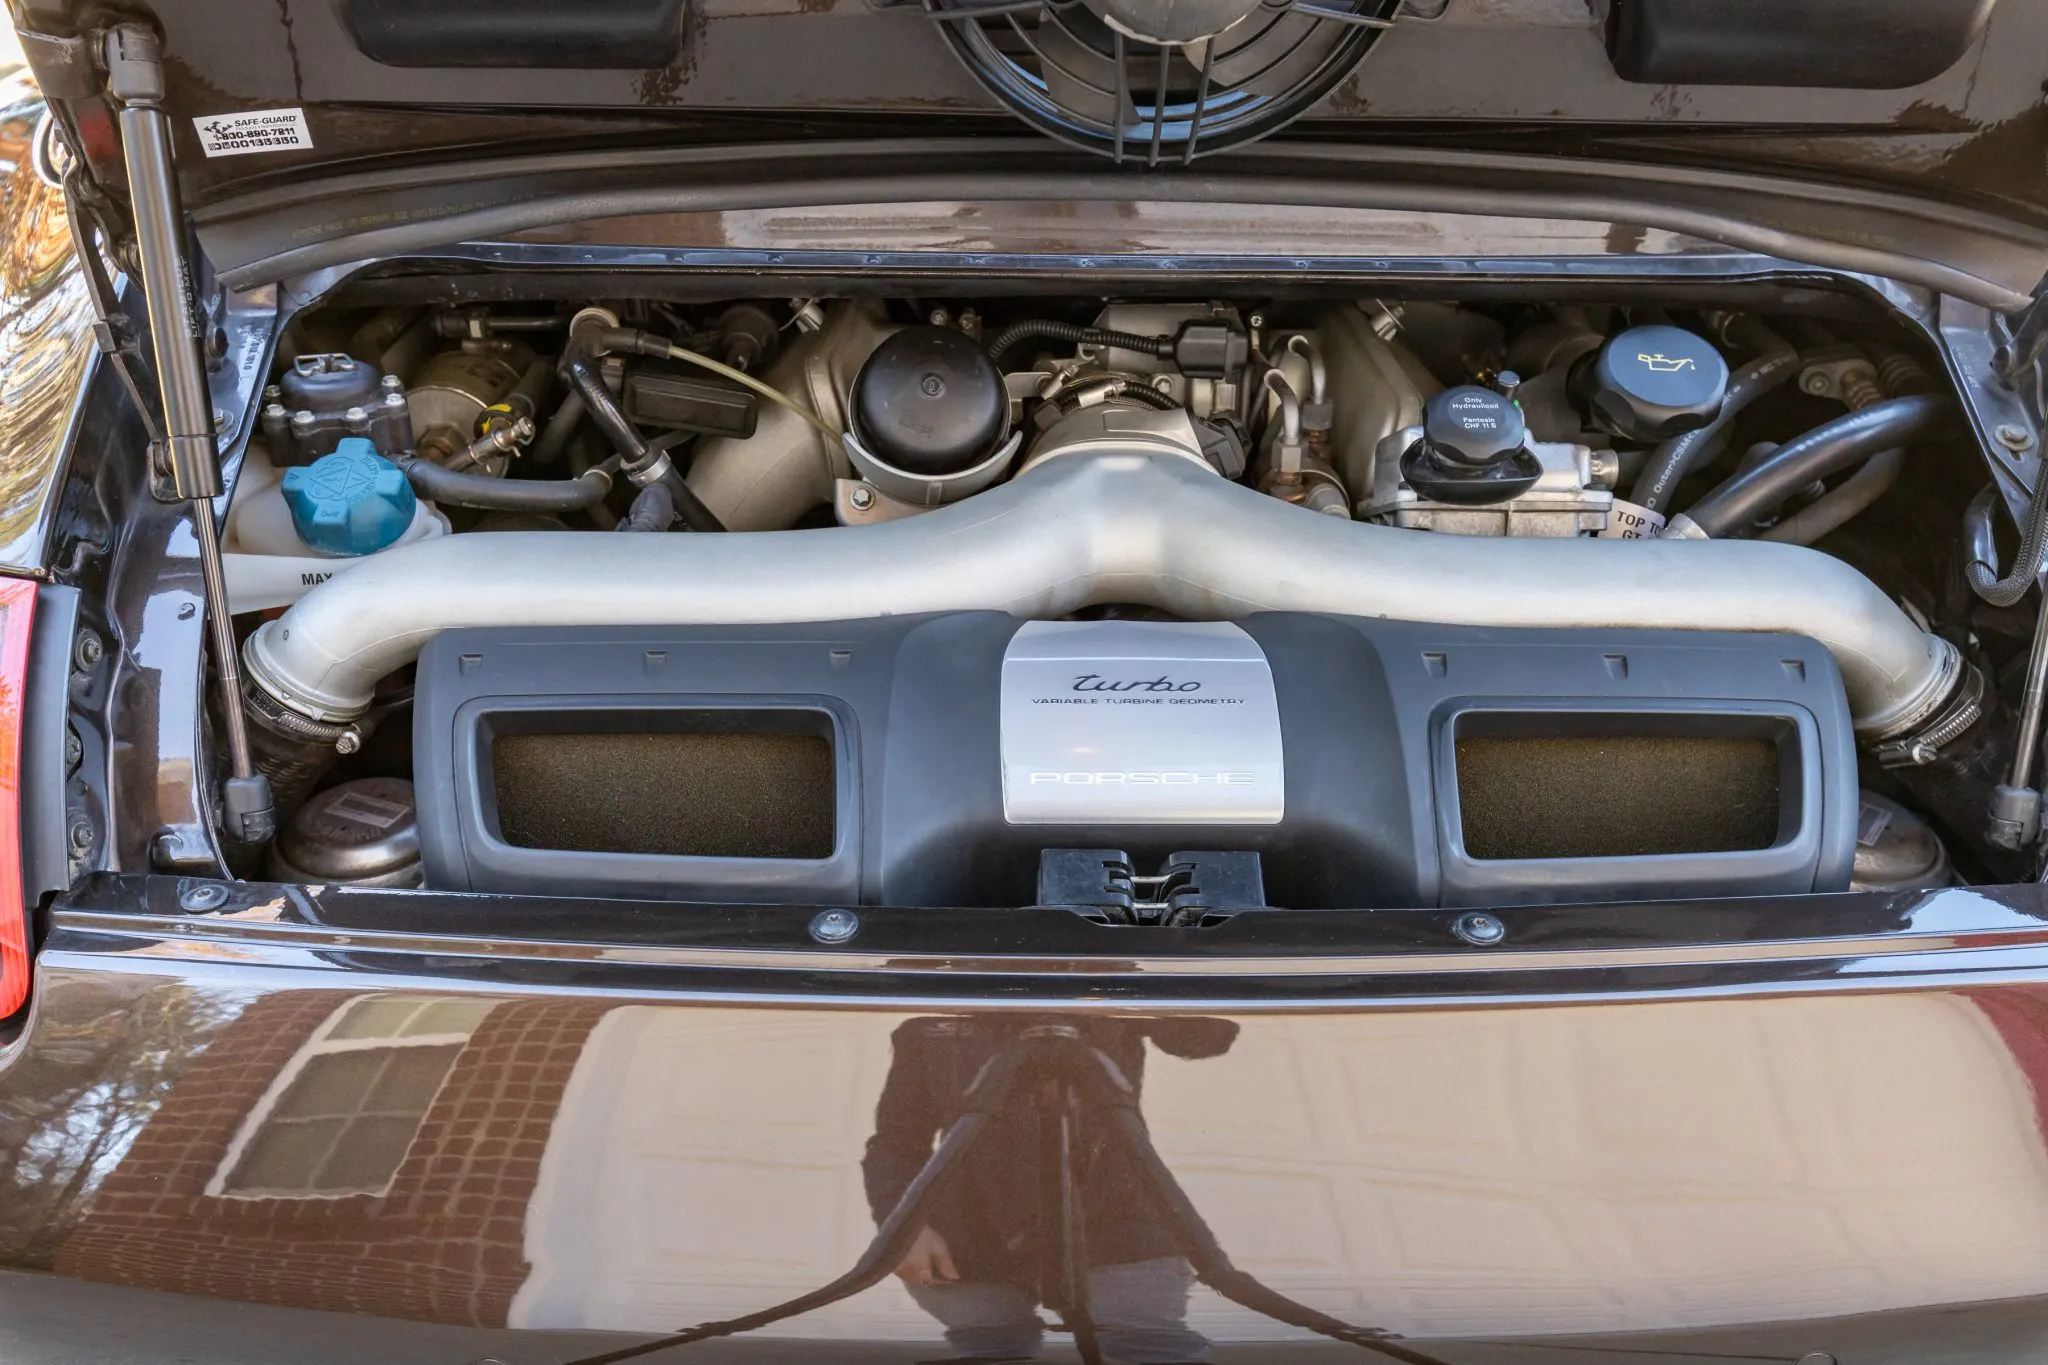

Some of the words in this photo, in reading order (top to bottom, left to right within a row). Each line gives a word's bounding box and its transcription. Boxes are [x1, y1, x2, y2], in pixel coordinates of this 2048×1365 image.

[234, 115, 297, 127] SAFE-GUARD
[1617, 510, 1646, 529] TOP
[1072, 674, 1201, 692] turbo
[1029, 772, 1255, 785] PORSCHE
